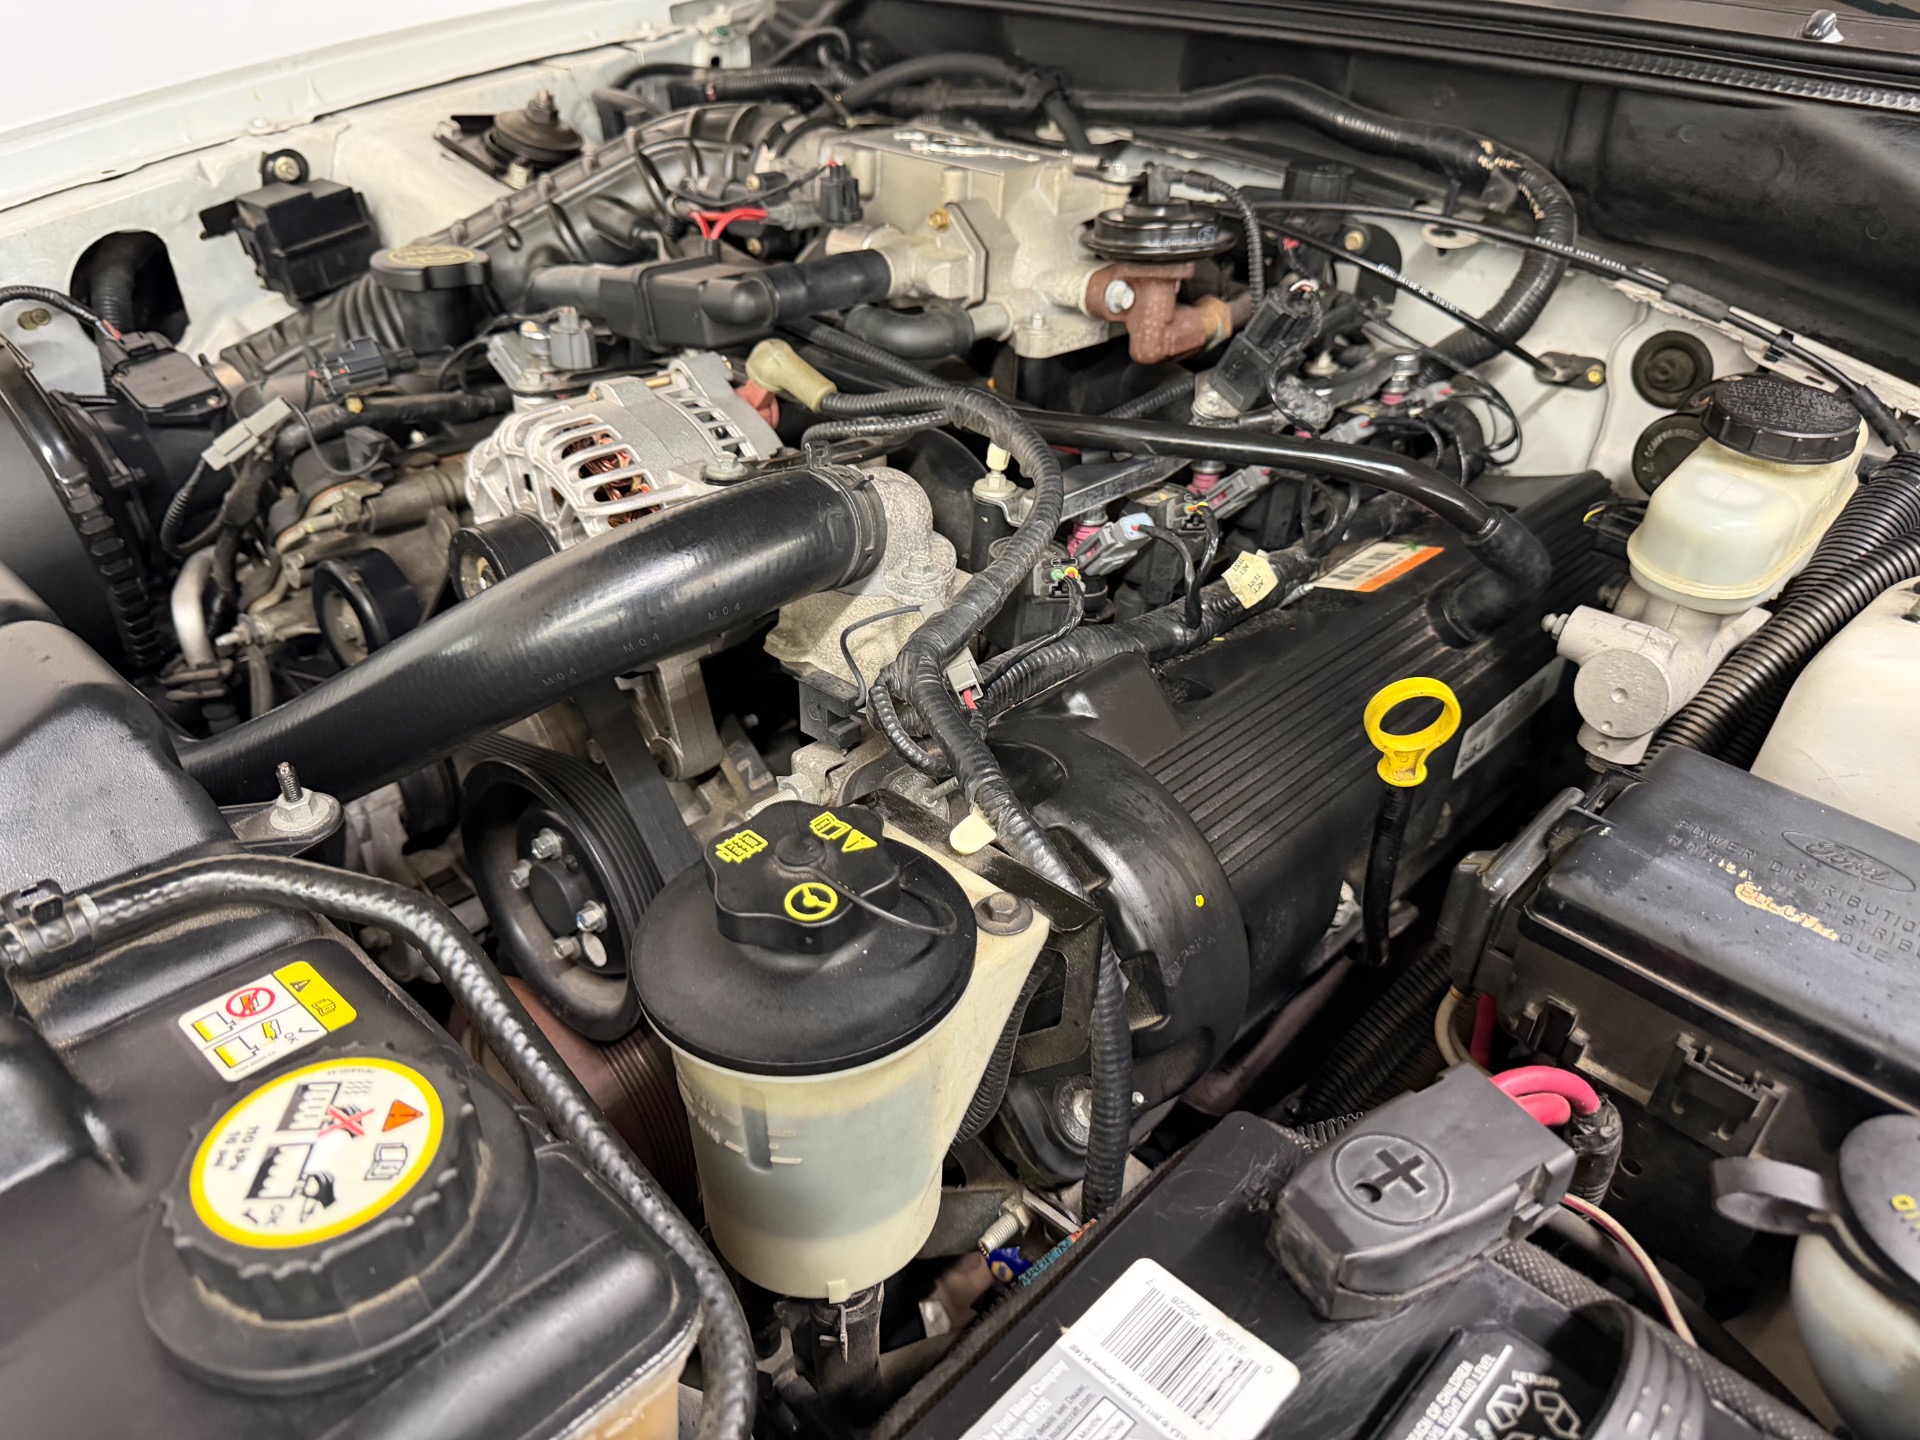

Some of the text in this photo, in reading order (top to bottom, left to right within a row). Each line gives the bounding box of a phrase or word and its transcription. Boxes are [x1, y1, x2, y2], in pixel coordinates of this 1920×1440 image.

[1675, 818, 1920, 932] POWER DISTRIBUTIO
[1805, 839, 1892, 882] Ford
[284, 1032, 299, 1044] OK
[264, 1204, 285, 1226] OK
[1171, 1295, 1202, 1320] 26228
[1030, 1360, 1070, 1396] Company
[1436, 1360, 1475, 1407] CHILDREN
[1458, 1378, 1478, 1402] AND
[1471, 1354, 1498, 1381] LEVEL
